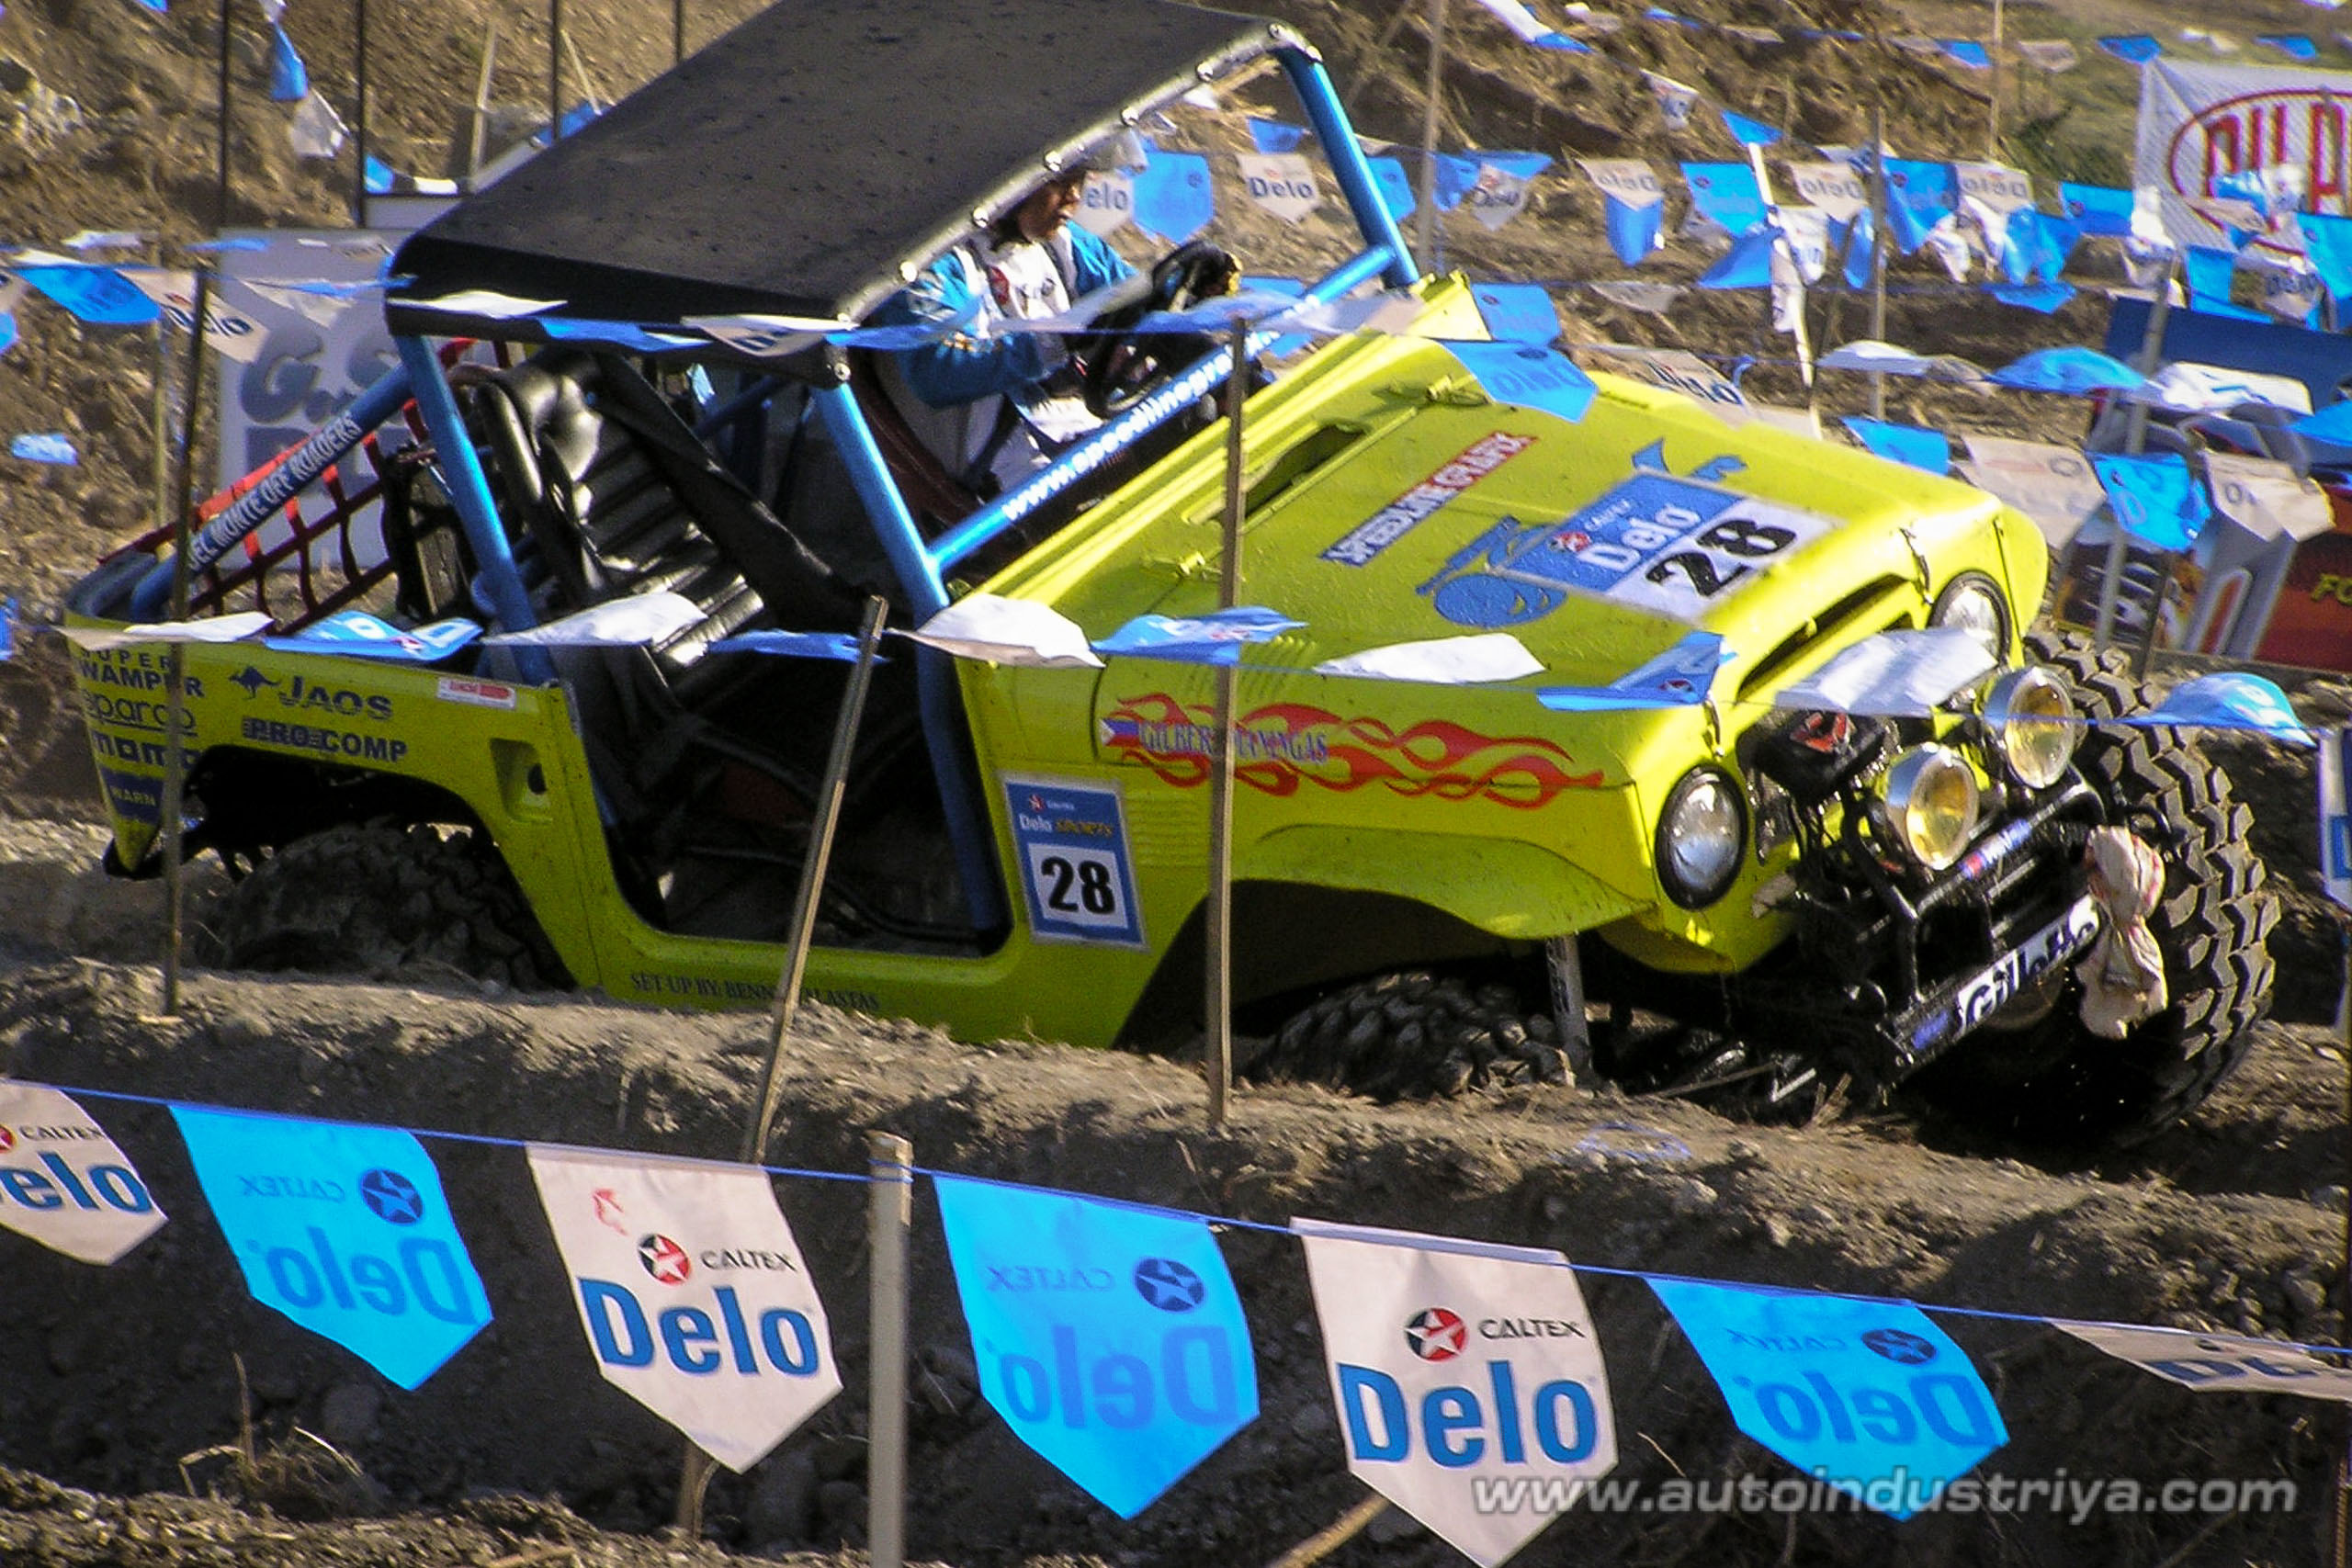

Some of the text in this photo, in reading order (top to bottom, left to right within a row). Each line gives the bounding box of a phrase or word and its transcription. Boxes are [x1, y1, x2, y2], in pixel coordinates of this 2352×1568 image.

[1084, 180, 1129, 210] elo
[1249, 176, 1314, 199] Delo
[210, 498, 268, 548] MONTE
[259, 470, 294, 505] OFF
[288, 410, 363, 481] ROADERS
[1576, 503, 1702, 572] Delo
[1645, 519, 1797, 597] 28
[278, 675, 393, 721] JAOS
[1040, 855, 1116, 915] 28
[0, 1150, 154, 1214] elo
[699, 1247, 798, 1273] CALTEX
[577, 1276, 820, 1377] Delo
[1478, 1316, 1587, 1342] CALTEX
[1336, 1359, 1600, 1468] Delo
